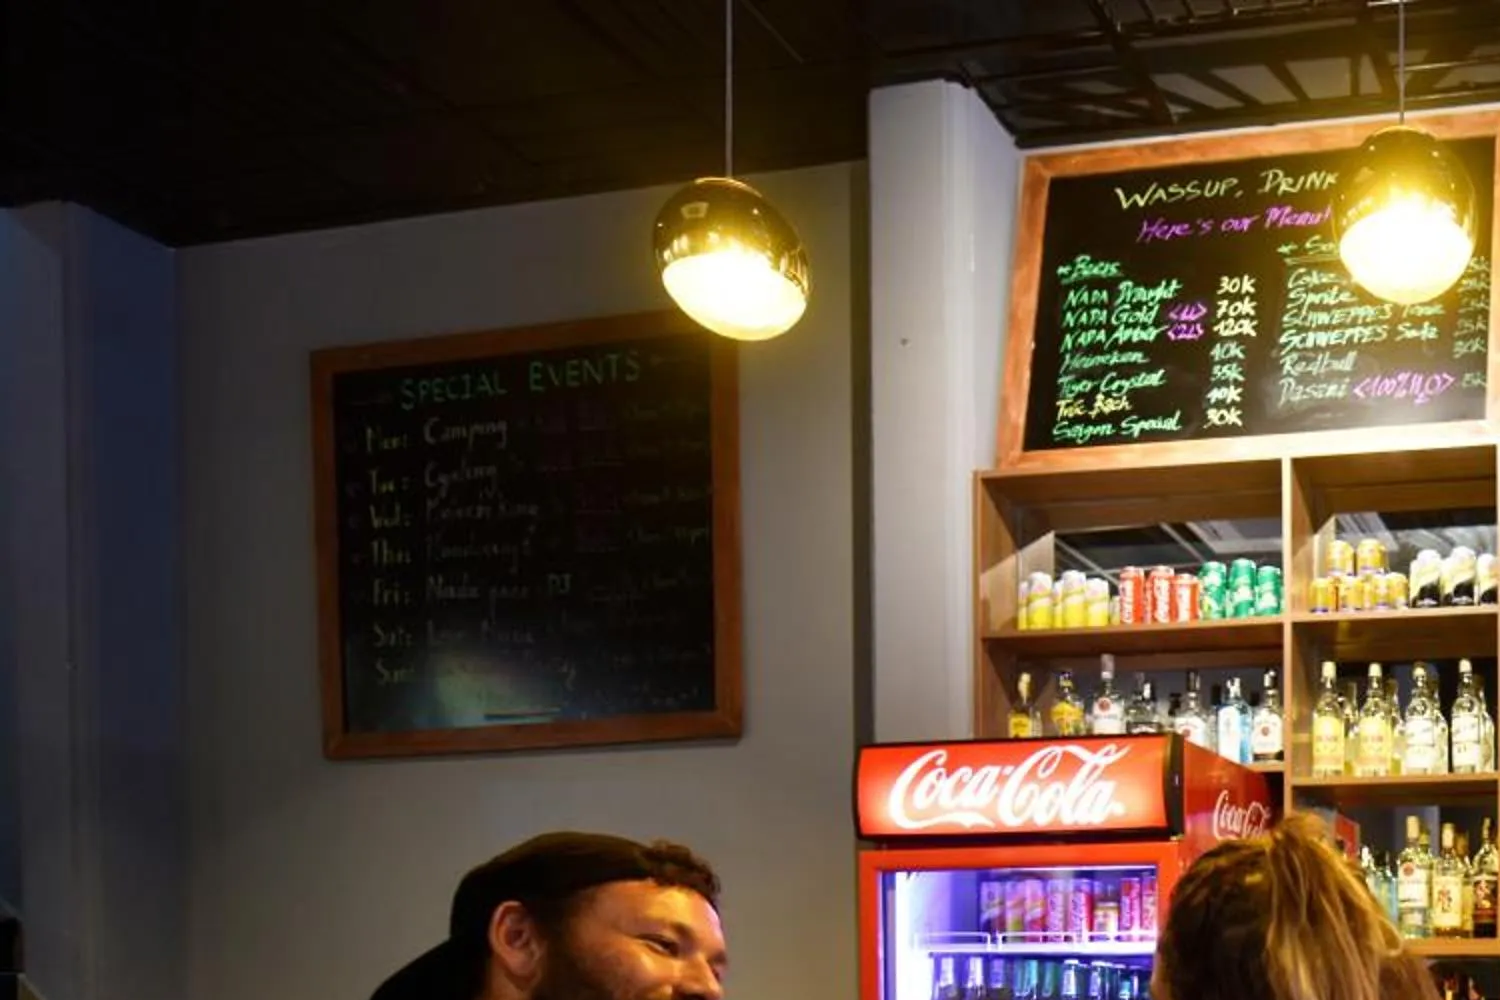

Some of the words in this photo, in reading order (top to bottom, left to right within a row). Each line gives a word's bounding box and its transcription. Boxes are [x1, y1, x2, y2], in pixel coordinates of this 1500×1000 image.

[401, 370, 508, 411] SPECIAL
[529, 350, 641, 393] EVENTS
[888, 744, 1131, 829] Coca-Cola
